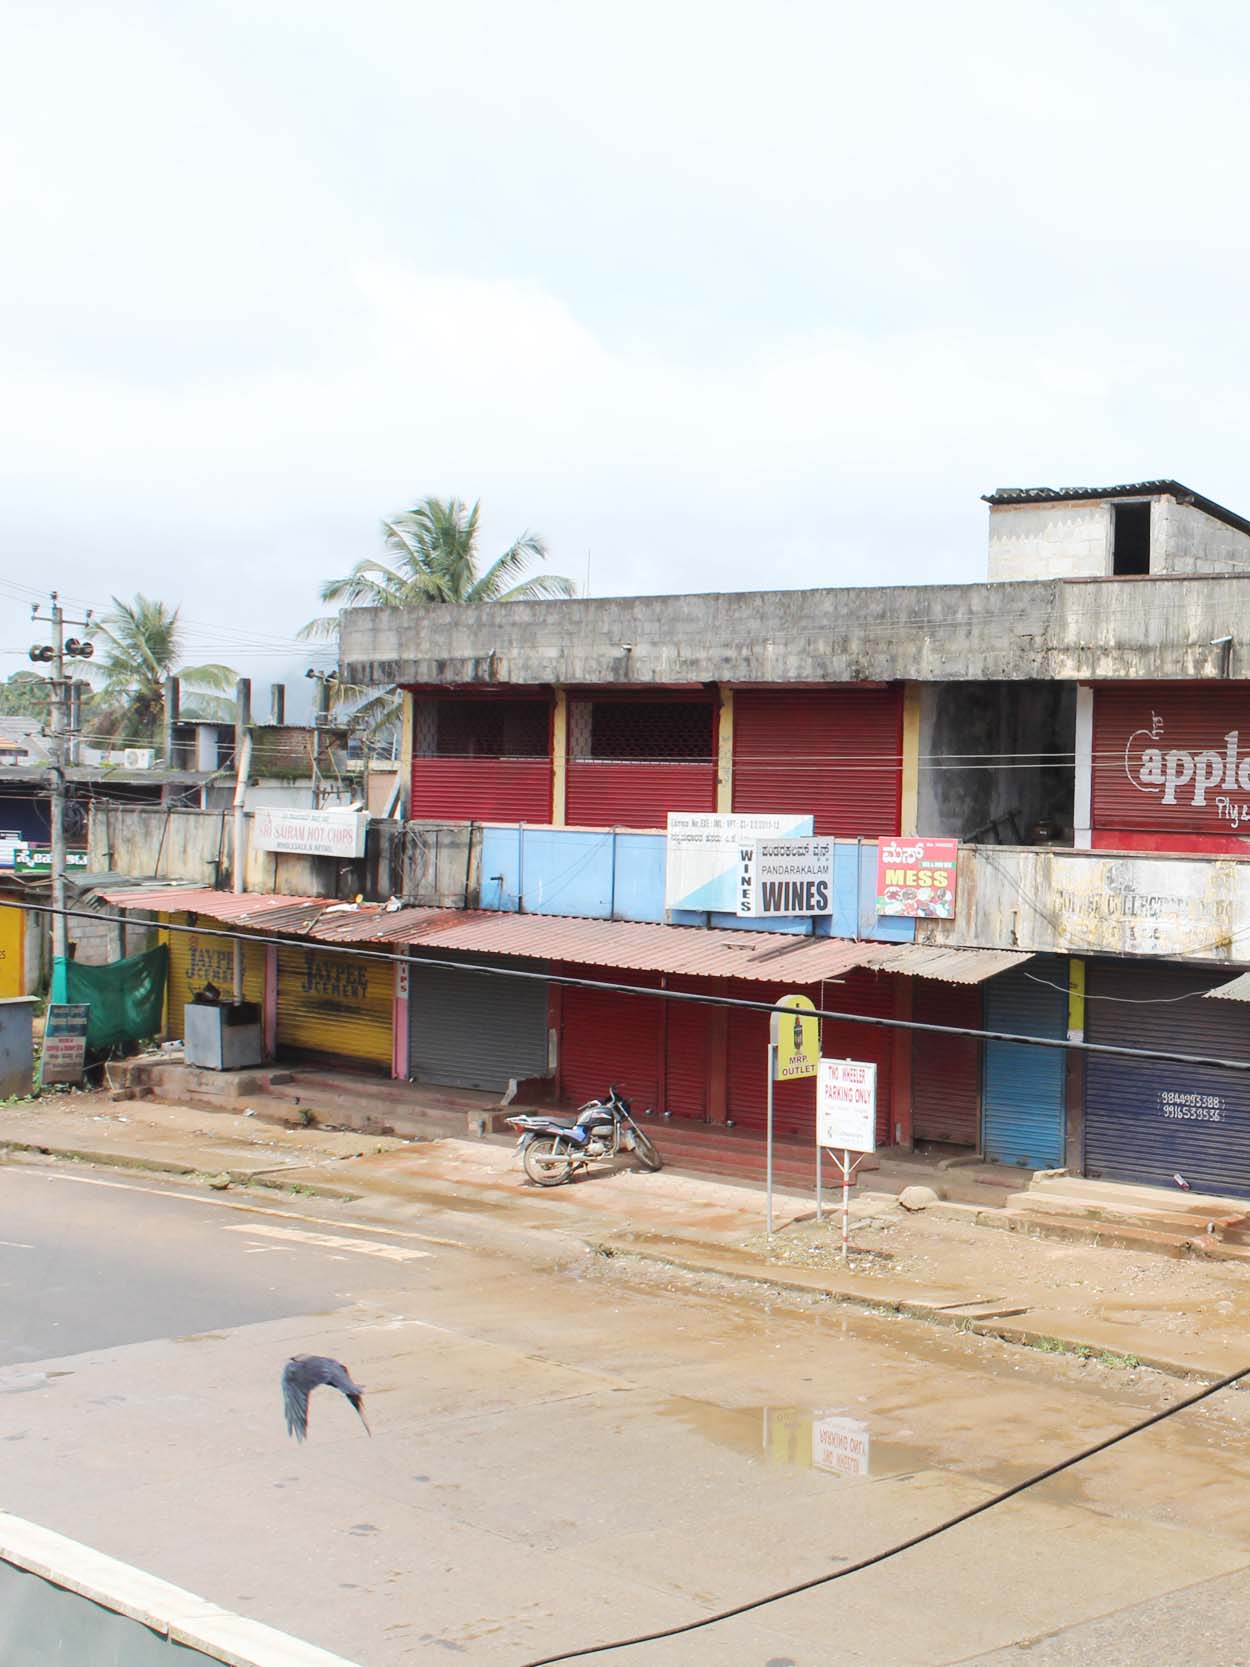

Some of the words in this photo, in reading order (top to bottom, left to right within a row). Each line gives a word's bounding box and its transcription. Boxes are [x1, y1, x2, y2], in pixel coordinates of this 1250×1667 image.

[1216, 796, 1239, 829] Ply
[761, 865, 829, 875] PANDARAKALAM
[885, 869, 949, 888] MESS
[740, 849, 753, 912] WINES
[762, 880, 829, 912] WINES
[315, 982, 368, 998] CEMENT
[782, 1064, 816, 1077] OUTLET
[825, 1084, 854, 1103] PARKING
[855, 1087, 872, 1105] ONLY
